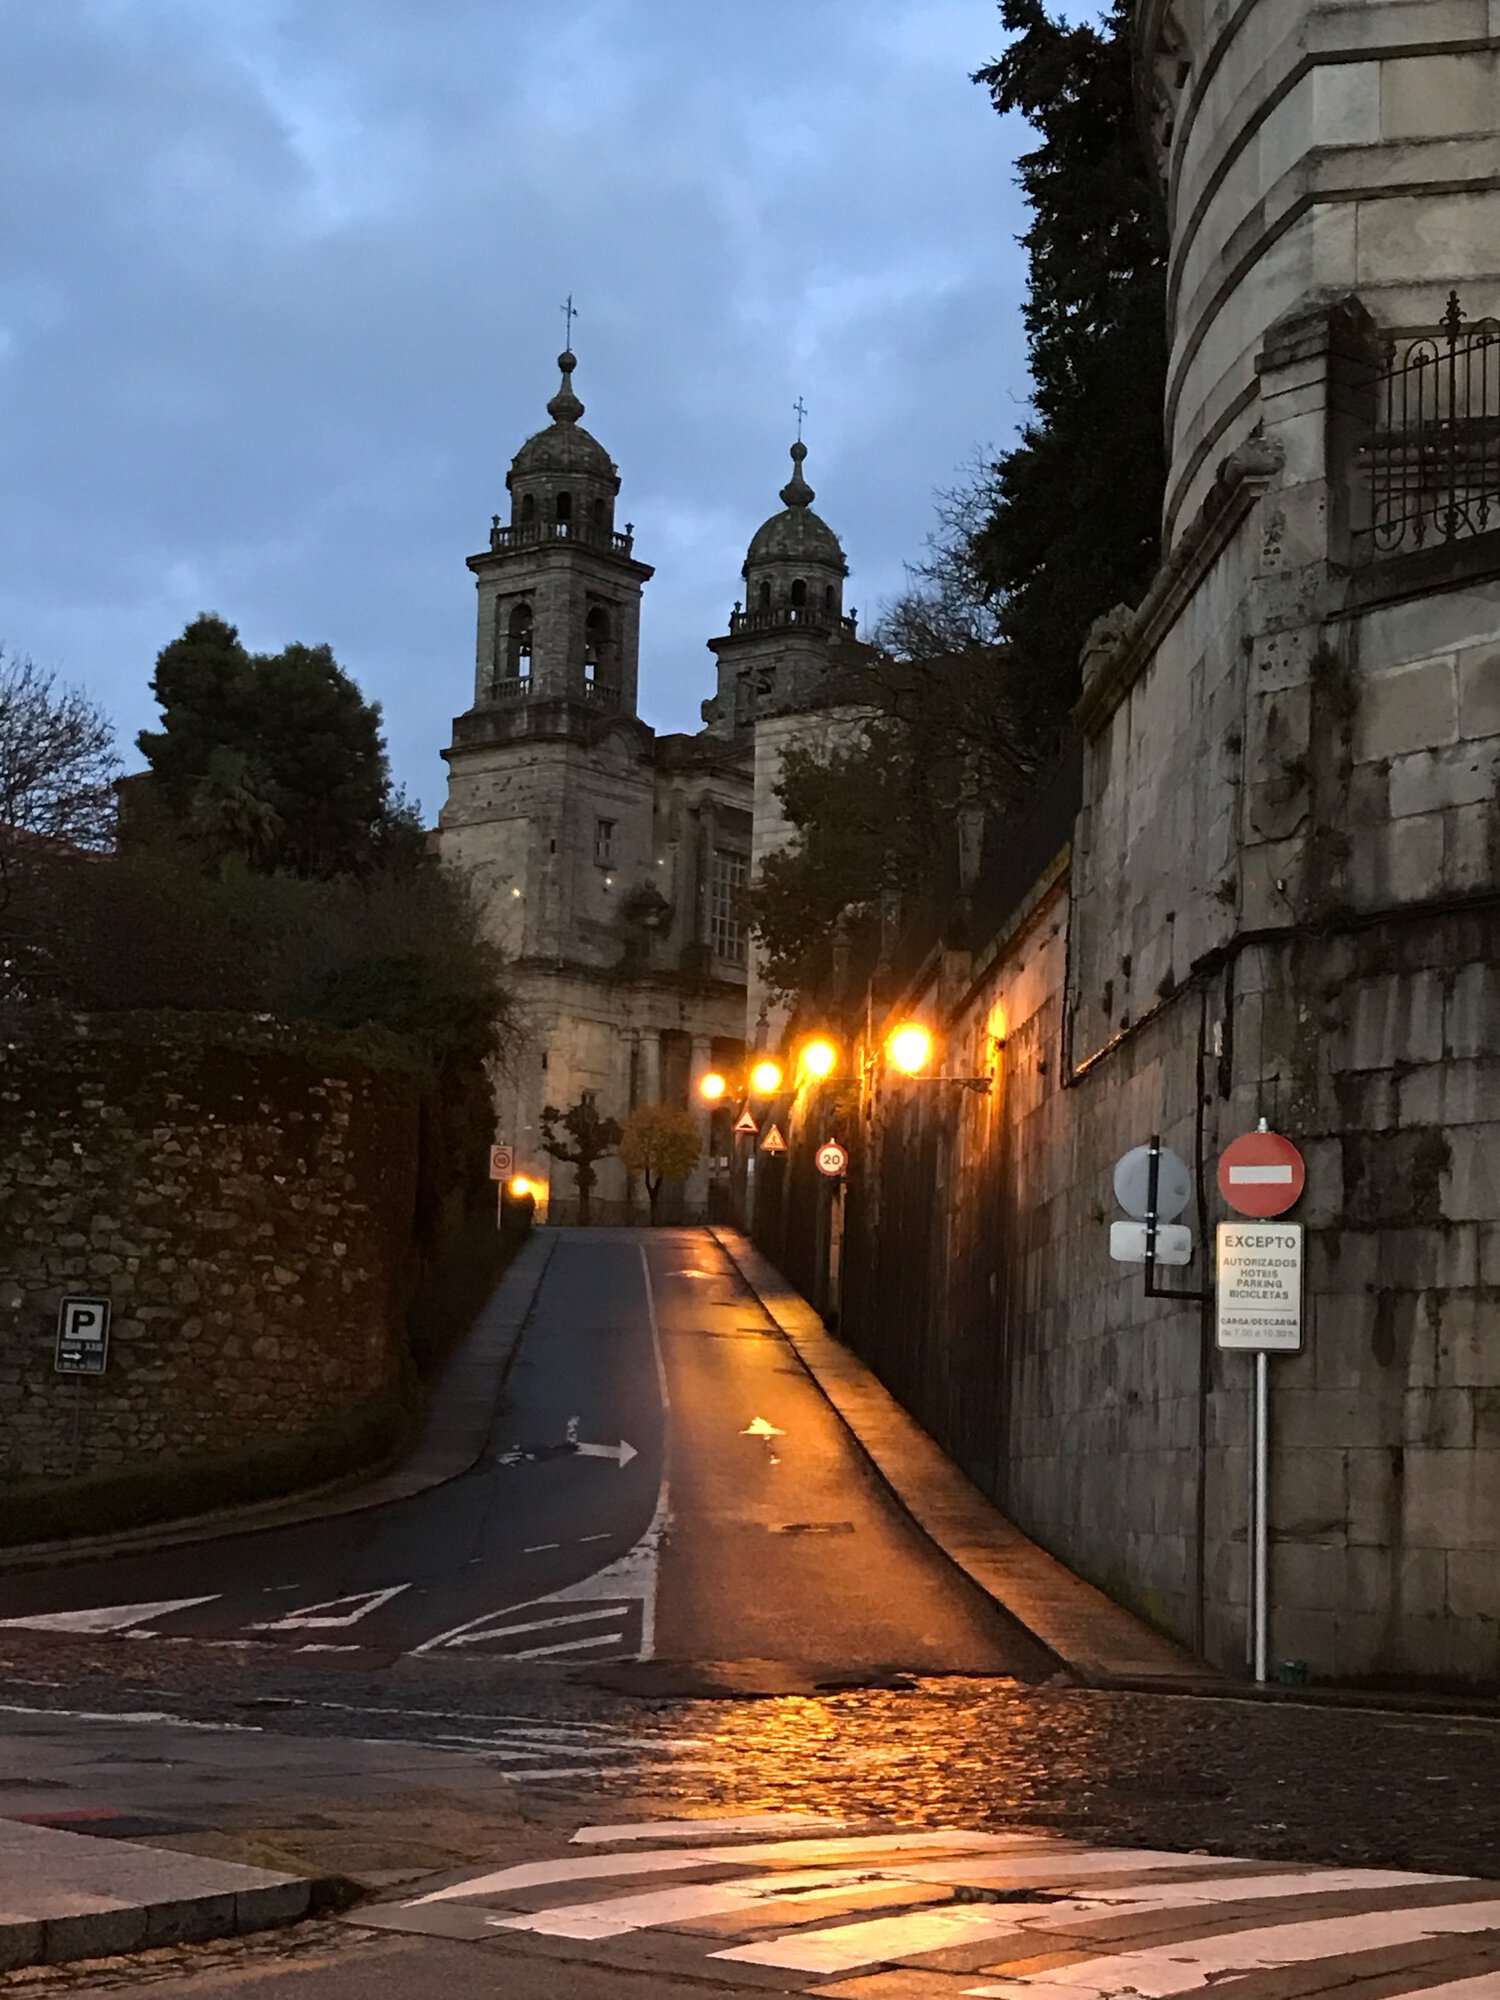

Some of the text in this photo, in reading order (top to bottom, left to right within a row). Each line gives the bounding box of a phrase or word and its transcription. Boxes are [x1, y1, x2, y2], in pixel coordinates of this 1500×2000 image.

[823, 1154, 841, 1165] 20
[1225, 1235, 1296, 1249] EXCEPTO
[1223, 1257, 1297, 1268] AUTORIZADOS
[1236, 1279, 1283, 1288] PARKING
[1229, 1289, 1289, 1300] BICICLETAS
[71, 1309, 96, 1334] P
